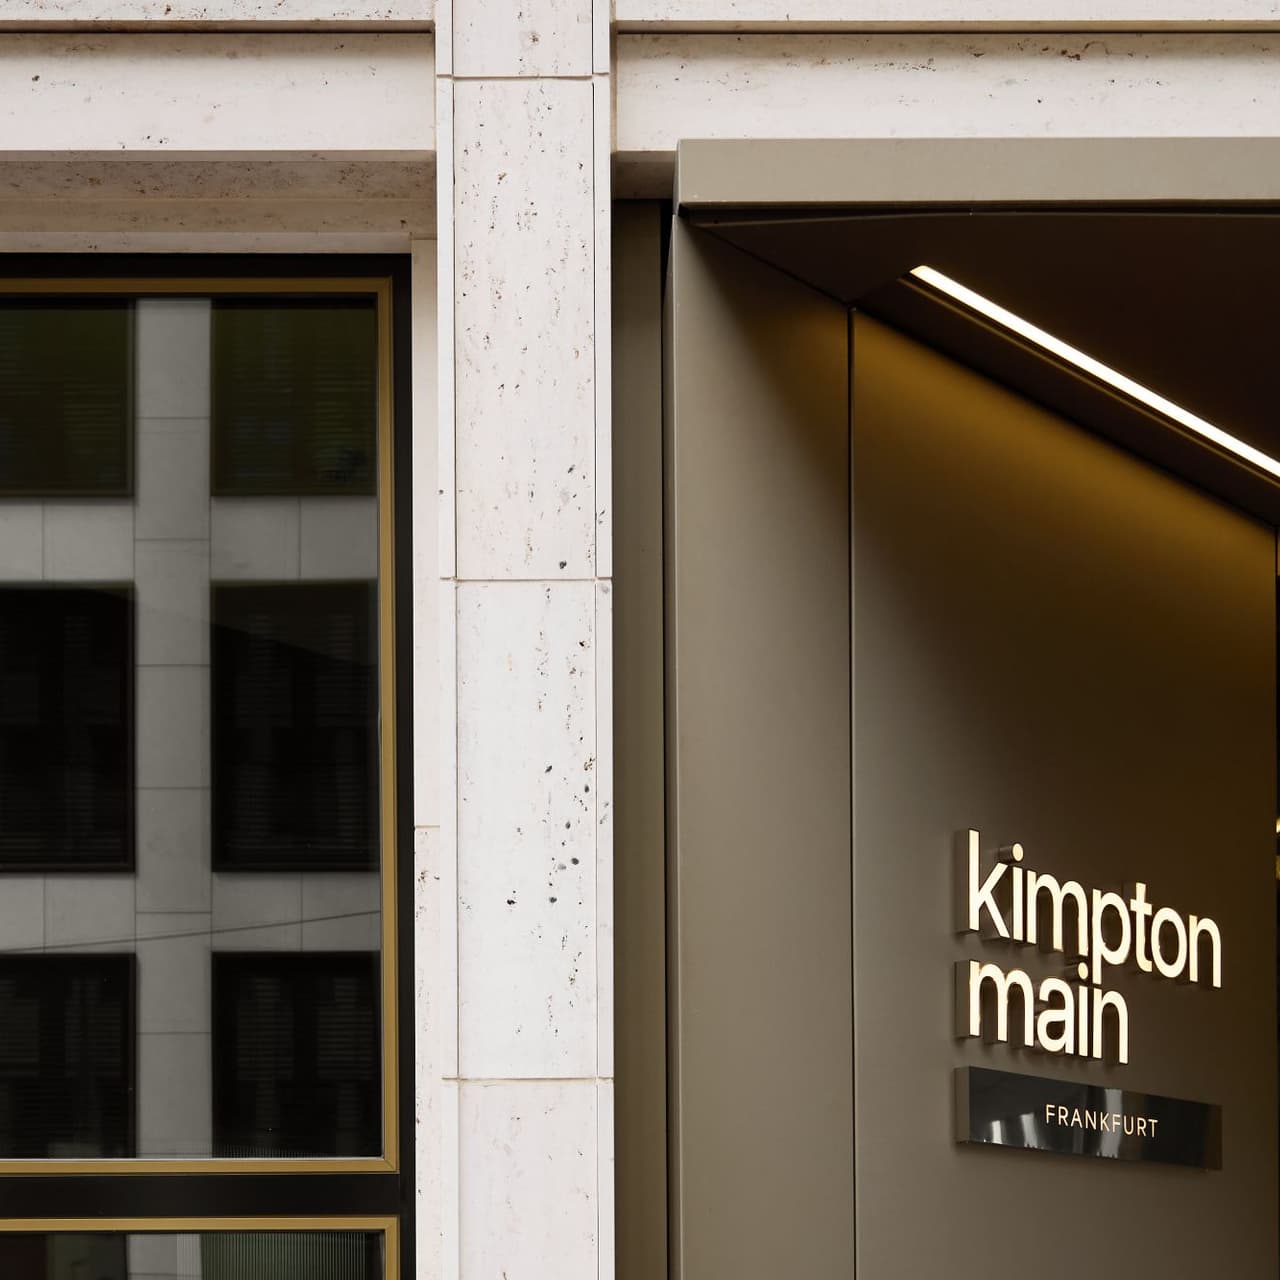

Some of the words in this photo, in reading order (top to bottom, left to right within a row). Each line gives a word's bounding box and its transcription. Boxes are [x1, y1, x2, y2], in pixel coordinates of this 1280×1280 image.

[969, 829, 1222, 988] kimpton
[969, 960, 1129, 1065] main
[1045, 1104, 1159, 1138] FRANKFURT
